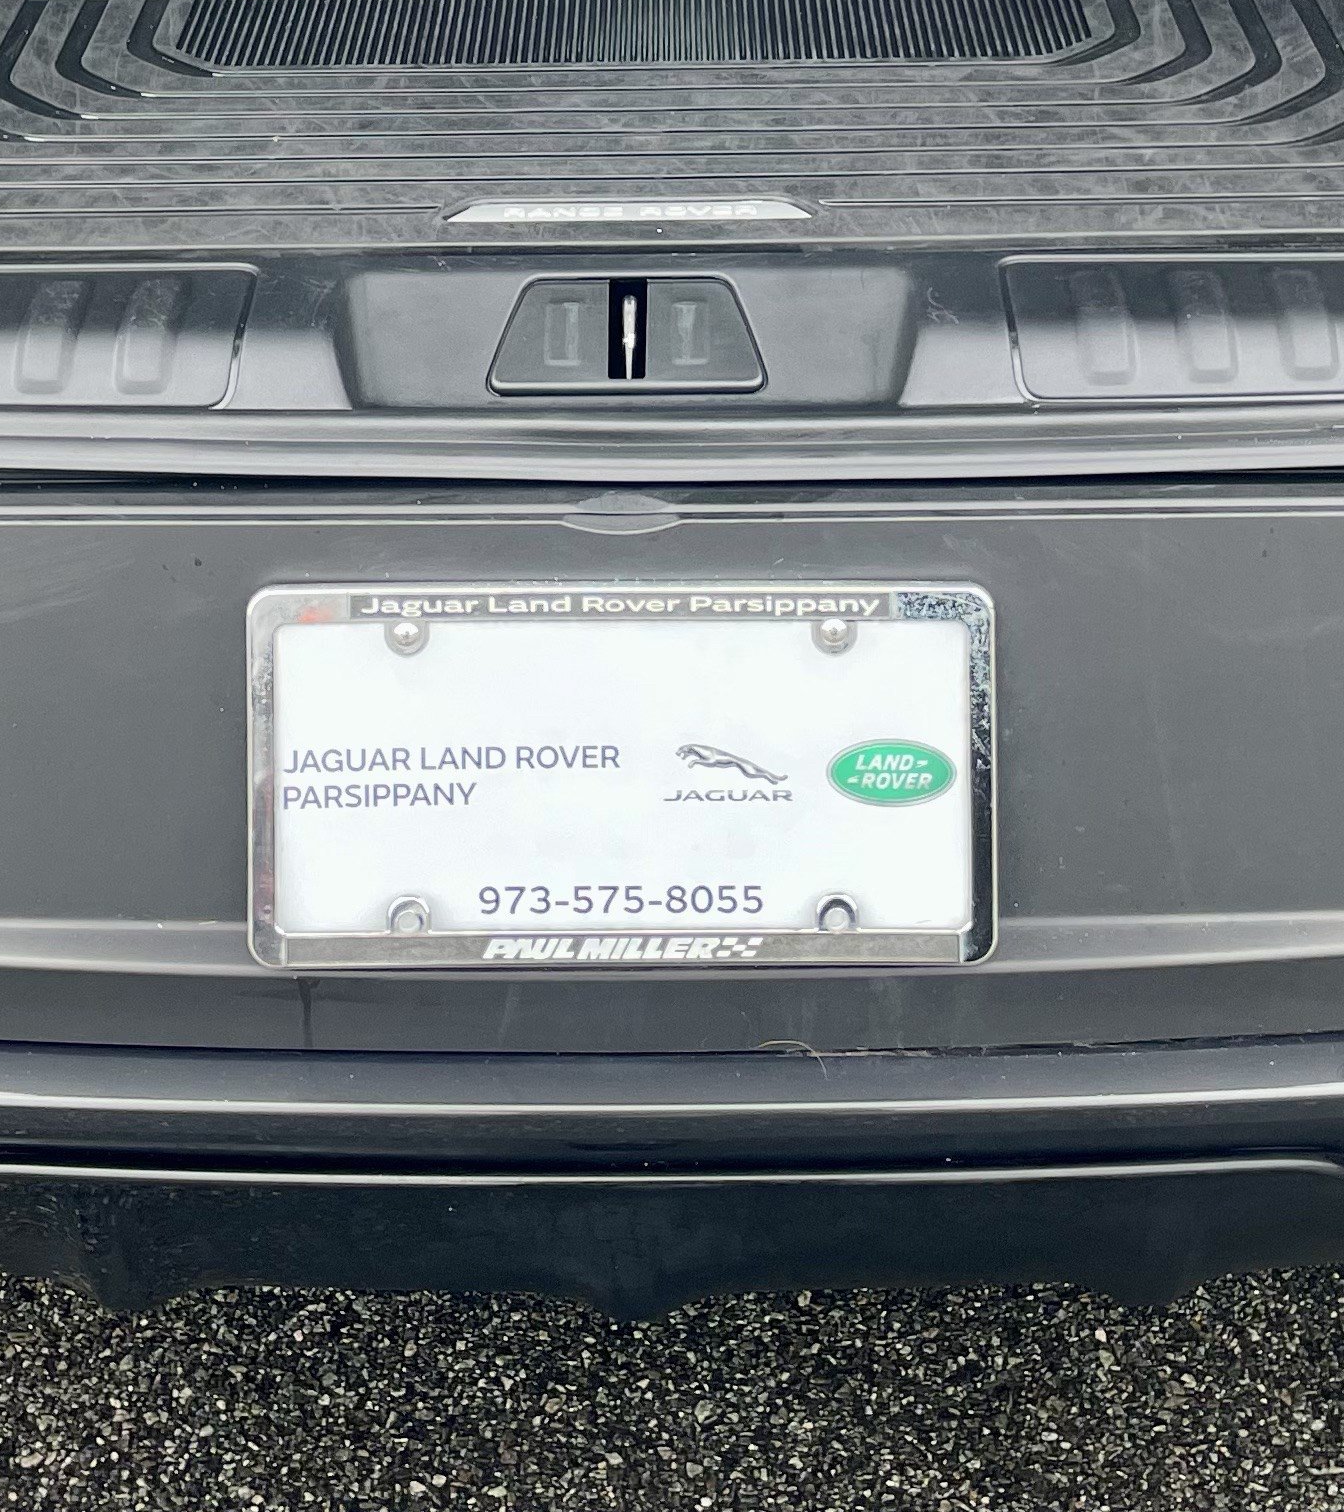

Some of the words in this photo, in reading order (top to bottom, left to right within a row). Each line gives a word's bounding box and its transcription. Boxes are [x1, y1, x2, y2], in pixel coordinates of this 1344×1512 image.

[360, 596, 479, 618] Jaguar
[488, 595, 572, 614] Land
[582, 595, 680, 613] Rover
[690, 595, 880, 617] Parsippany
[283, 747, 411, 773] JAGUAR
[420, 746, 506, 771] LAND
[515, 745, 621, 769] ROVER
[855, 754, 915, 771] LAND
[860, 772, 933, 790] ROVER
[283, 782, 477, 810] PARSIPPANY
[662, 789, 794, 802] JAGUAR
[478, 885, 764, 915] 973-575-8055
[482, 937, 575, 960] PAUL
[576, 936, 722, 960] MILLER
